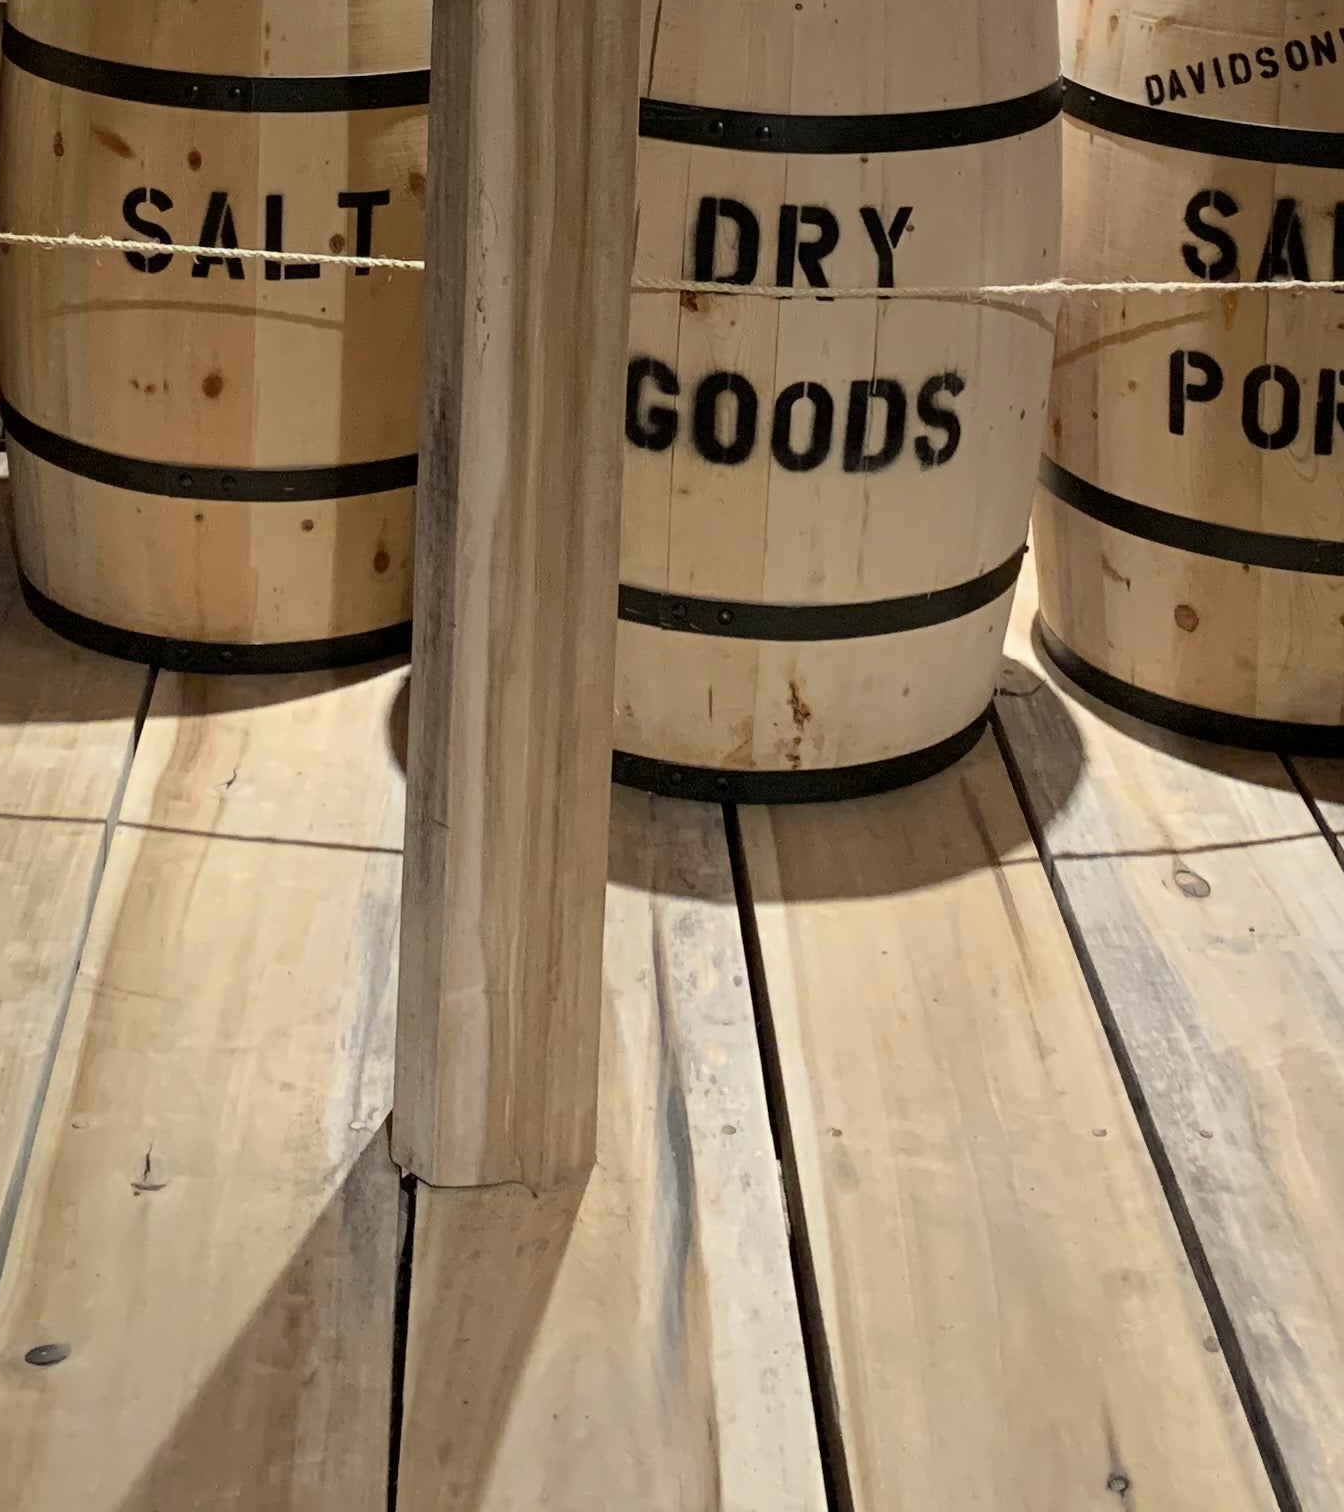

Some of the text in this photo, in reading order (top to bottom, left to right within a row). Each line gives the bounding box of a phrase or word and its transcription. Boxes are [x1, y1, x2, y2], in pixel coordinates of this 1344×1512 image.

[121, 187, 391, 281] SALT
[693, 196, 914, 302] DRY
[624, 355, 967, 473] GOODS
